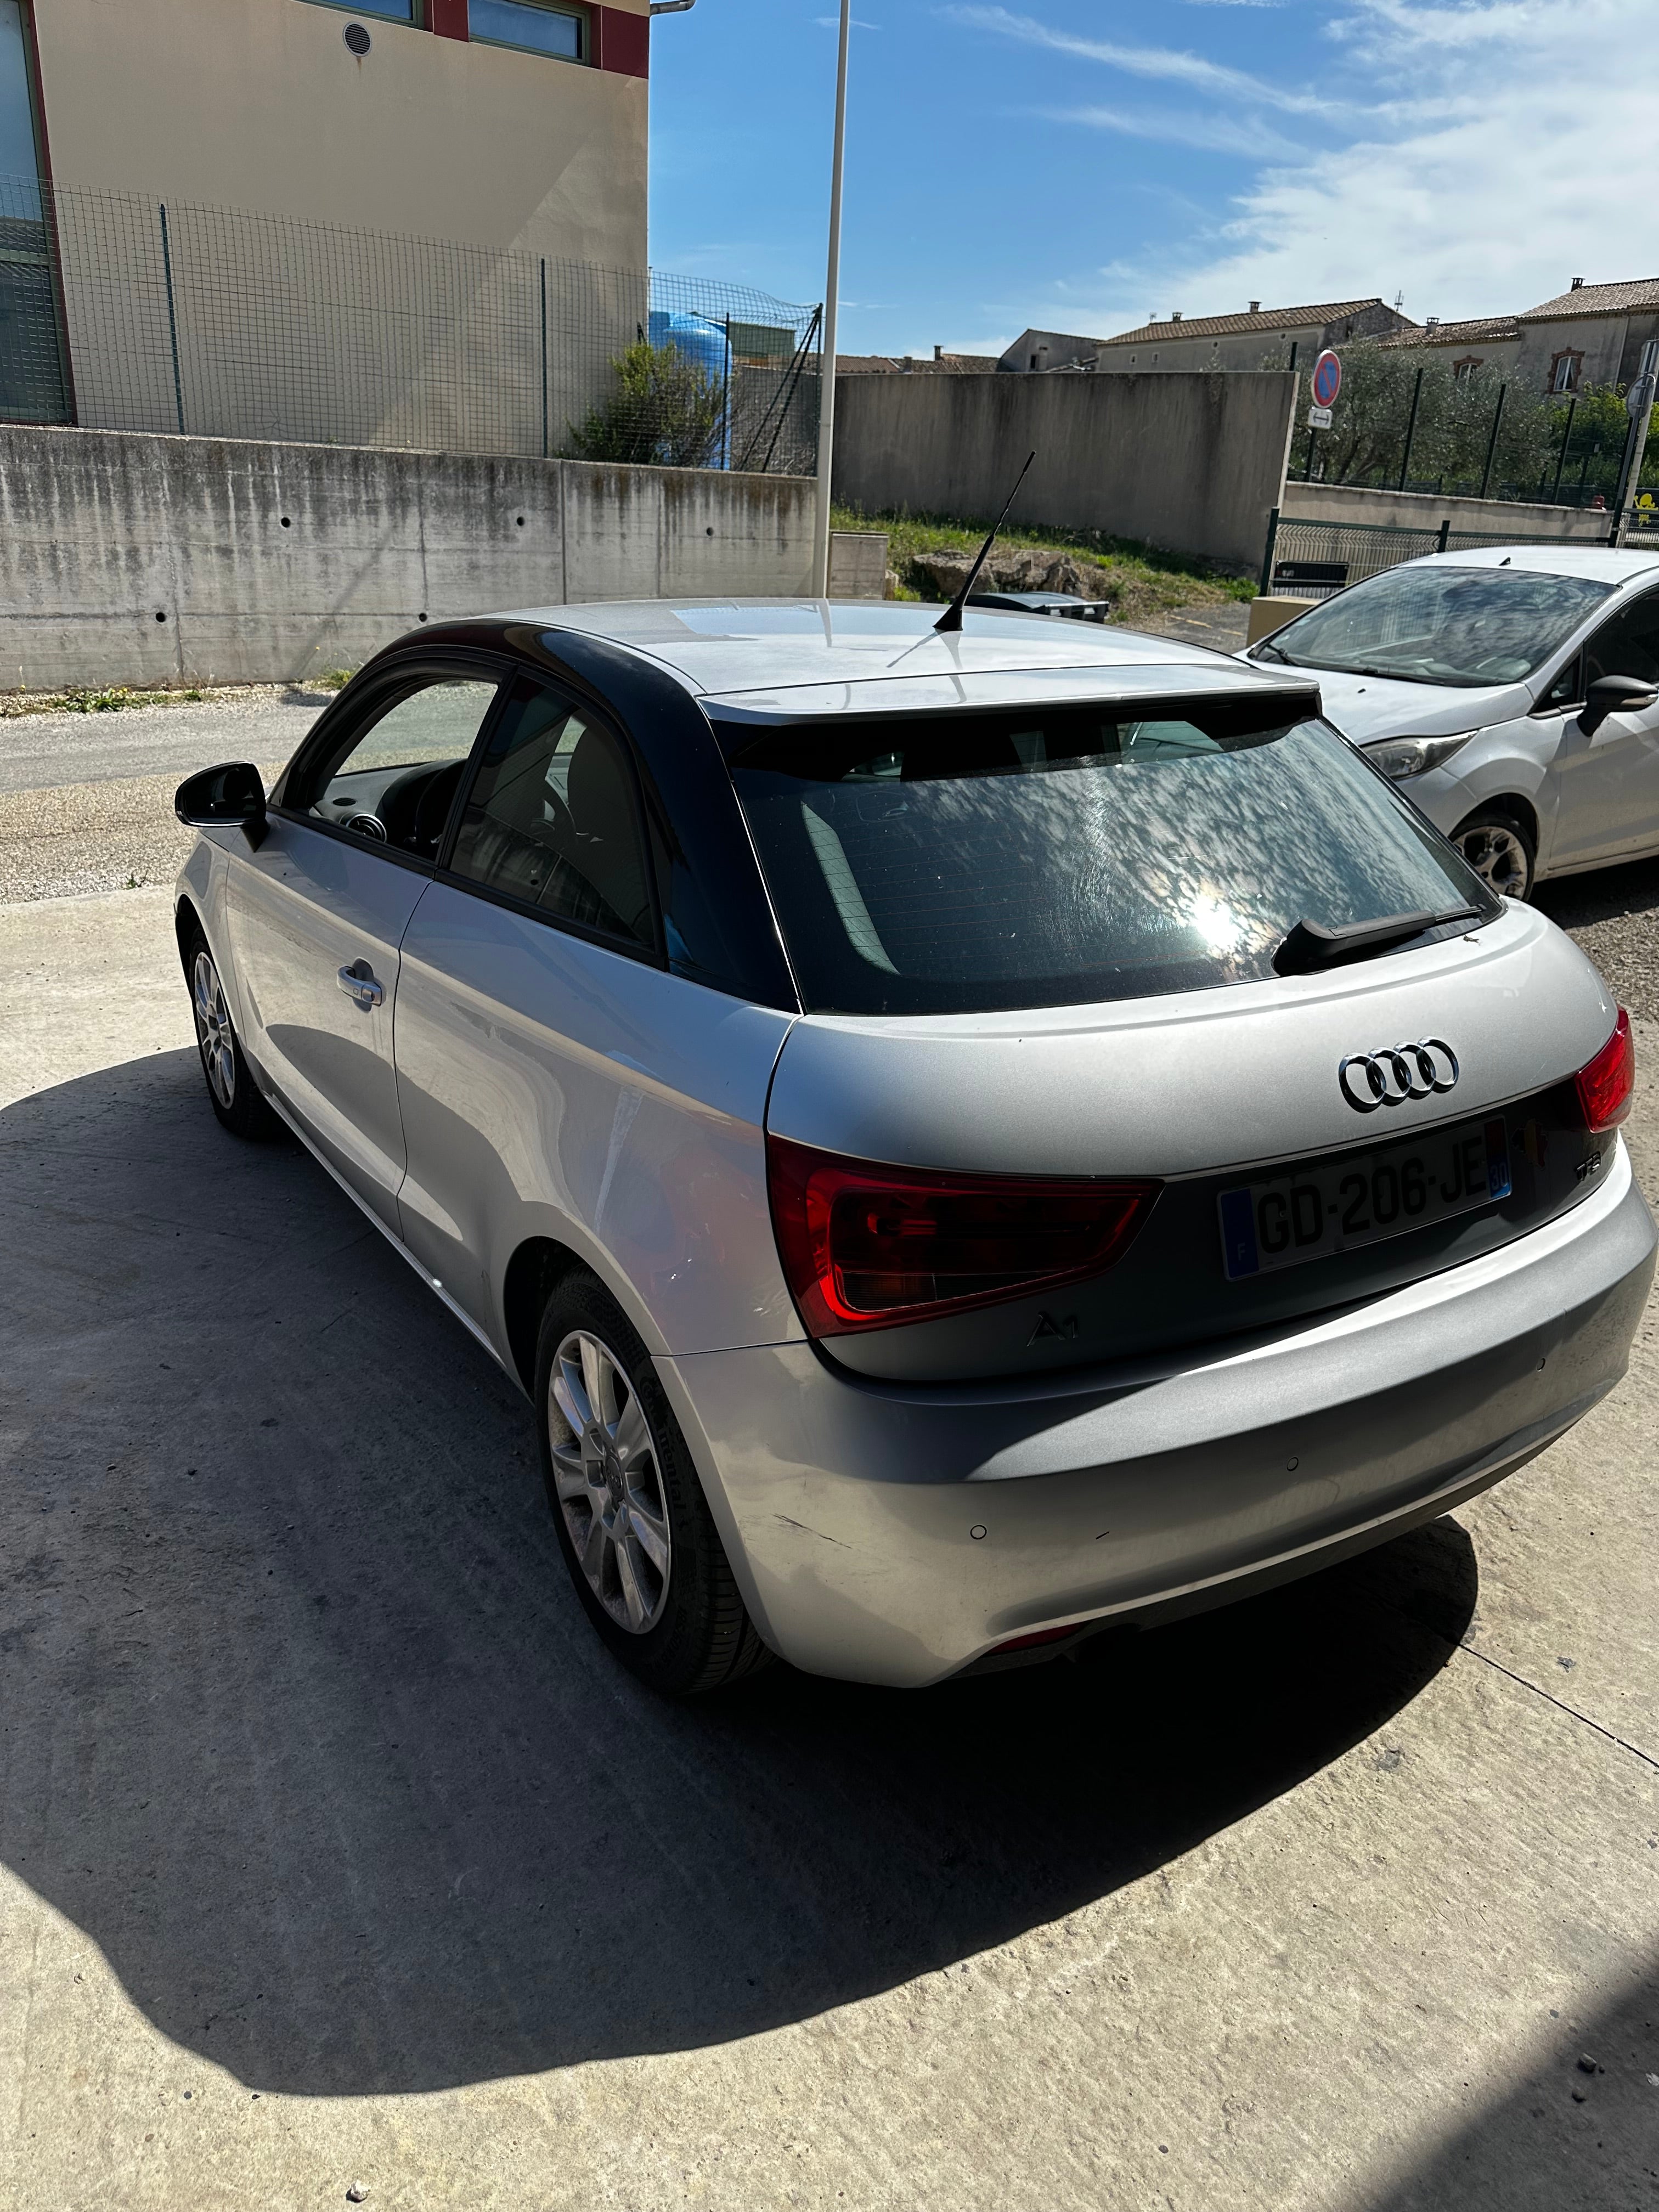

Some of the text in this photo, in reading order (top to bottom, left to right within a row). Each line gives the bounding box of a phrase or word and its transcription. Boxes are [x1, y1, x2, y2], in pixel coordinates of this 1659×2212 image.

[1489, 1161, 1509, 1191] 30
[1257, 1136, 1486, 1254] GD-206-JE
[1237, 1243, 1247, 1261] F
[1025, 1311, 1079, 1347] A1
